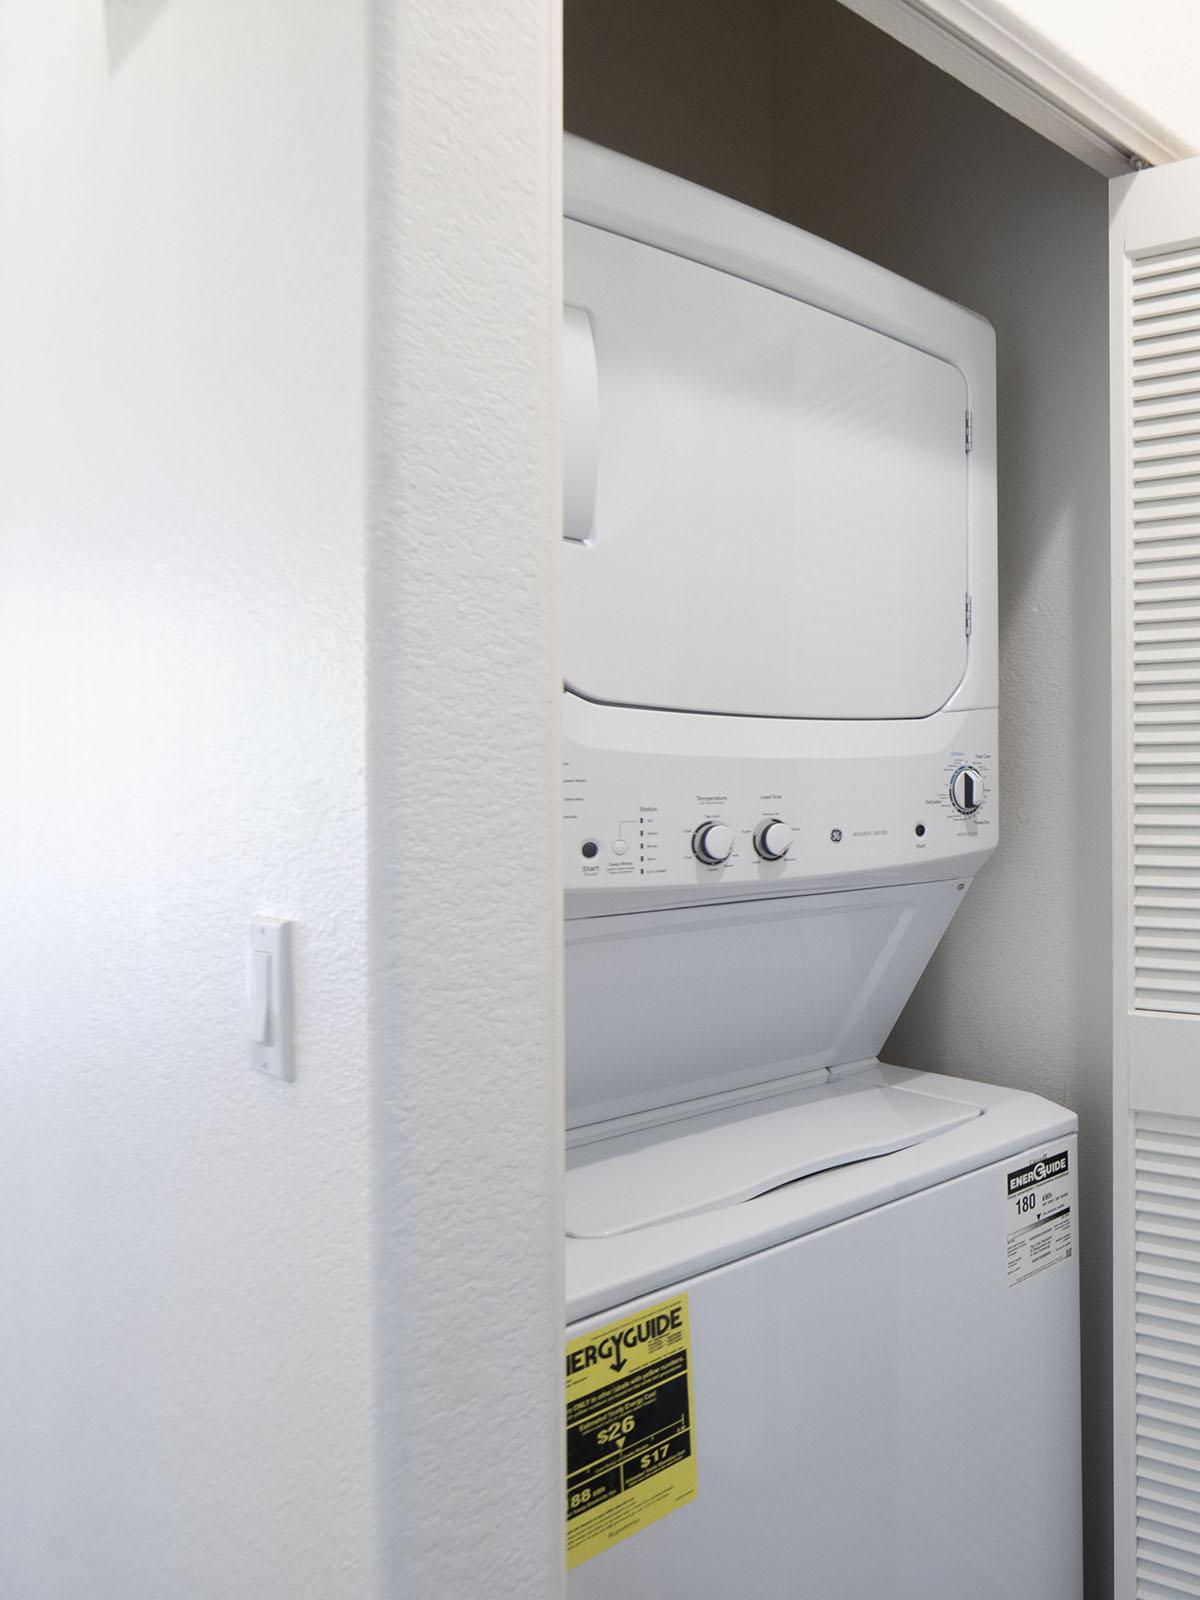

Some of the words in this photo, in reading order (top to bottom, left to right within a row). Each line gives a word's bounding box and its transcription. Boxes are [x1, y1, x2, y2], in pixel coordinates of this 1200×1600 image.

[1010, 1158, 1067, 1190] ENERGUIDE
[1016, 1192, 1036, 1215] 180
[597, 1415, 636, 1445] $26
[640, 1443, 671, 1469] $17
